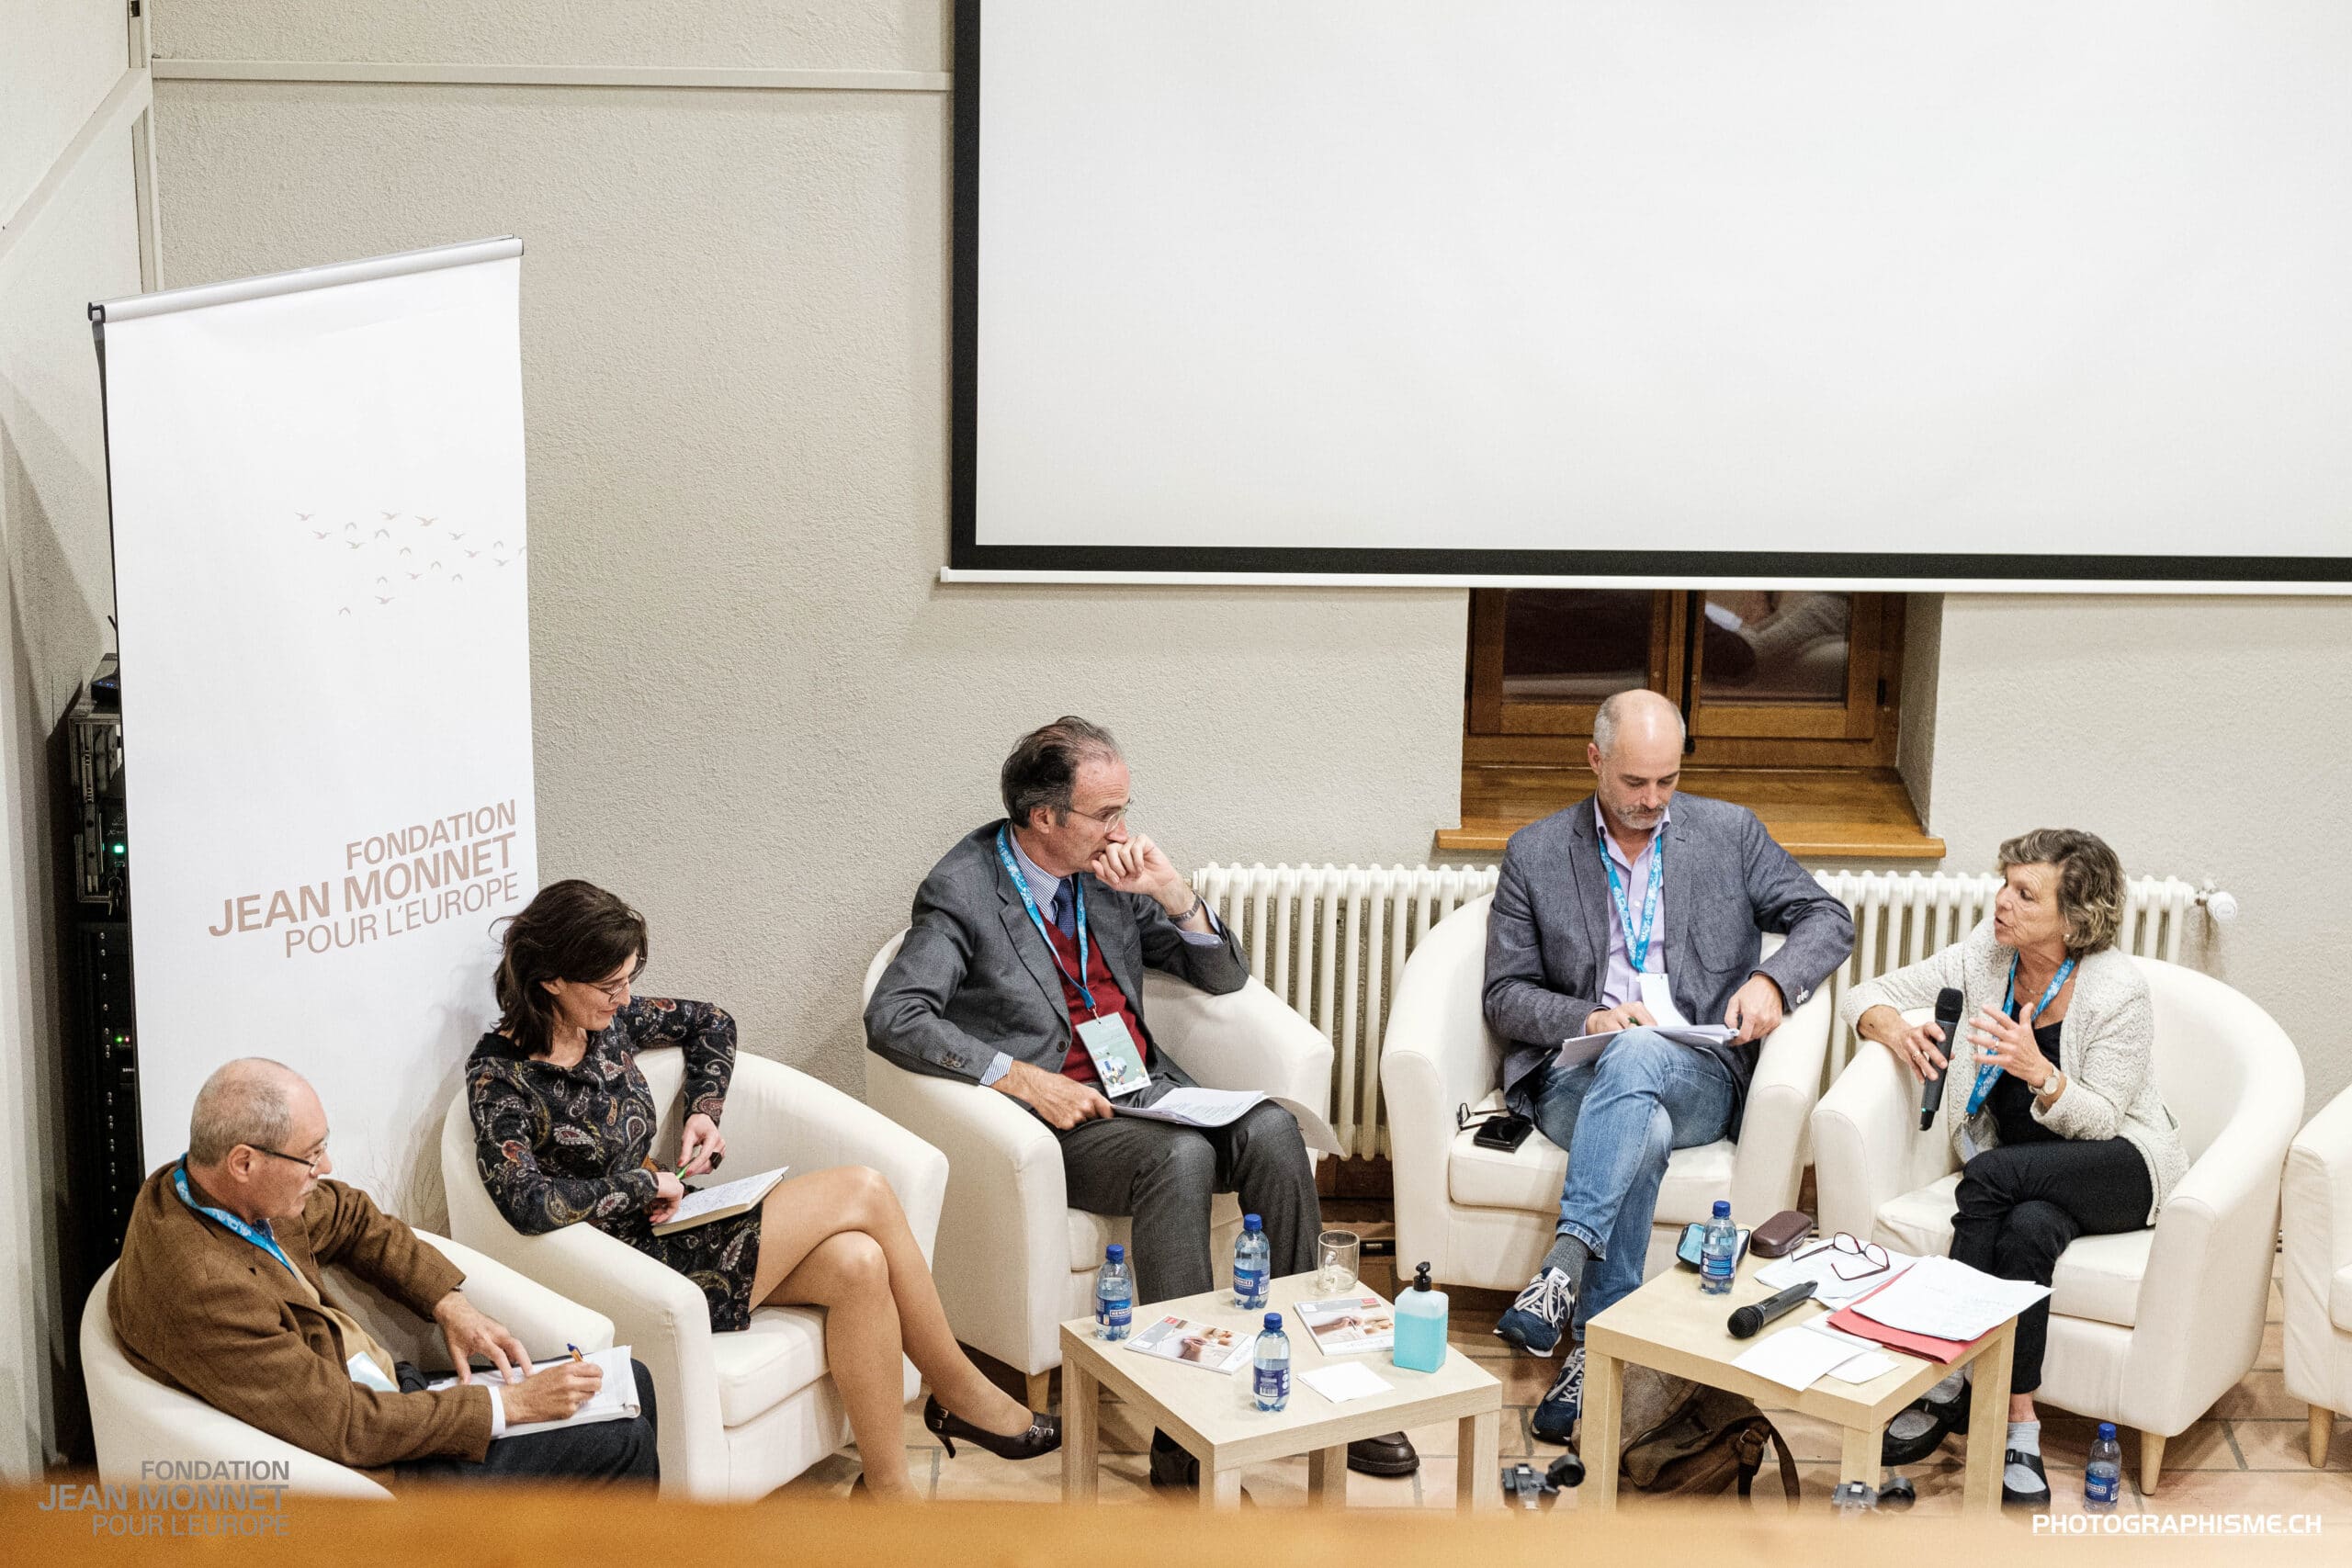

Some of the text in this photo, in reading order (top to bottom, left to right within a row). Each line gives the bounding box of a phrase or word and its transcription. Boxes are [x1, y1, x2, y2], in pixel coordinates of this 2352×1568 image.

[346, 799, 516, 870] FONDATION
[209, 831, 516, 937] JEAN MONNET
[286, 872, 519, 958] POUR L'EUROPE
